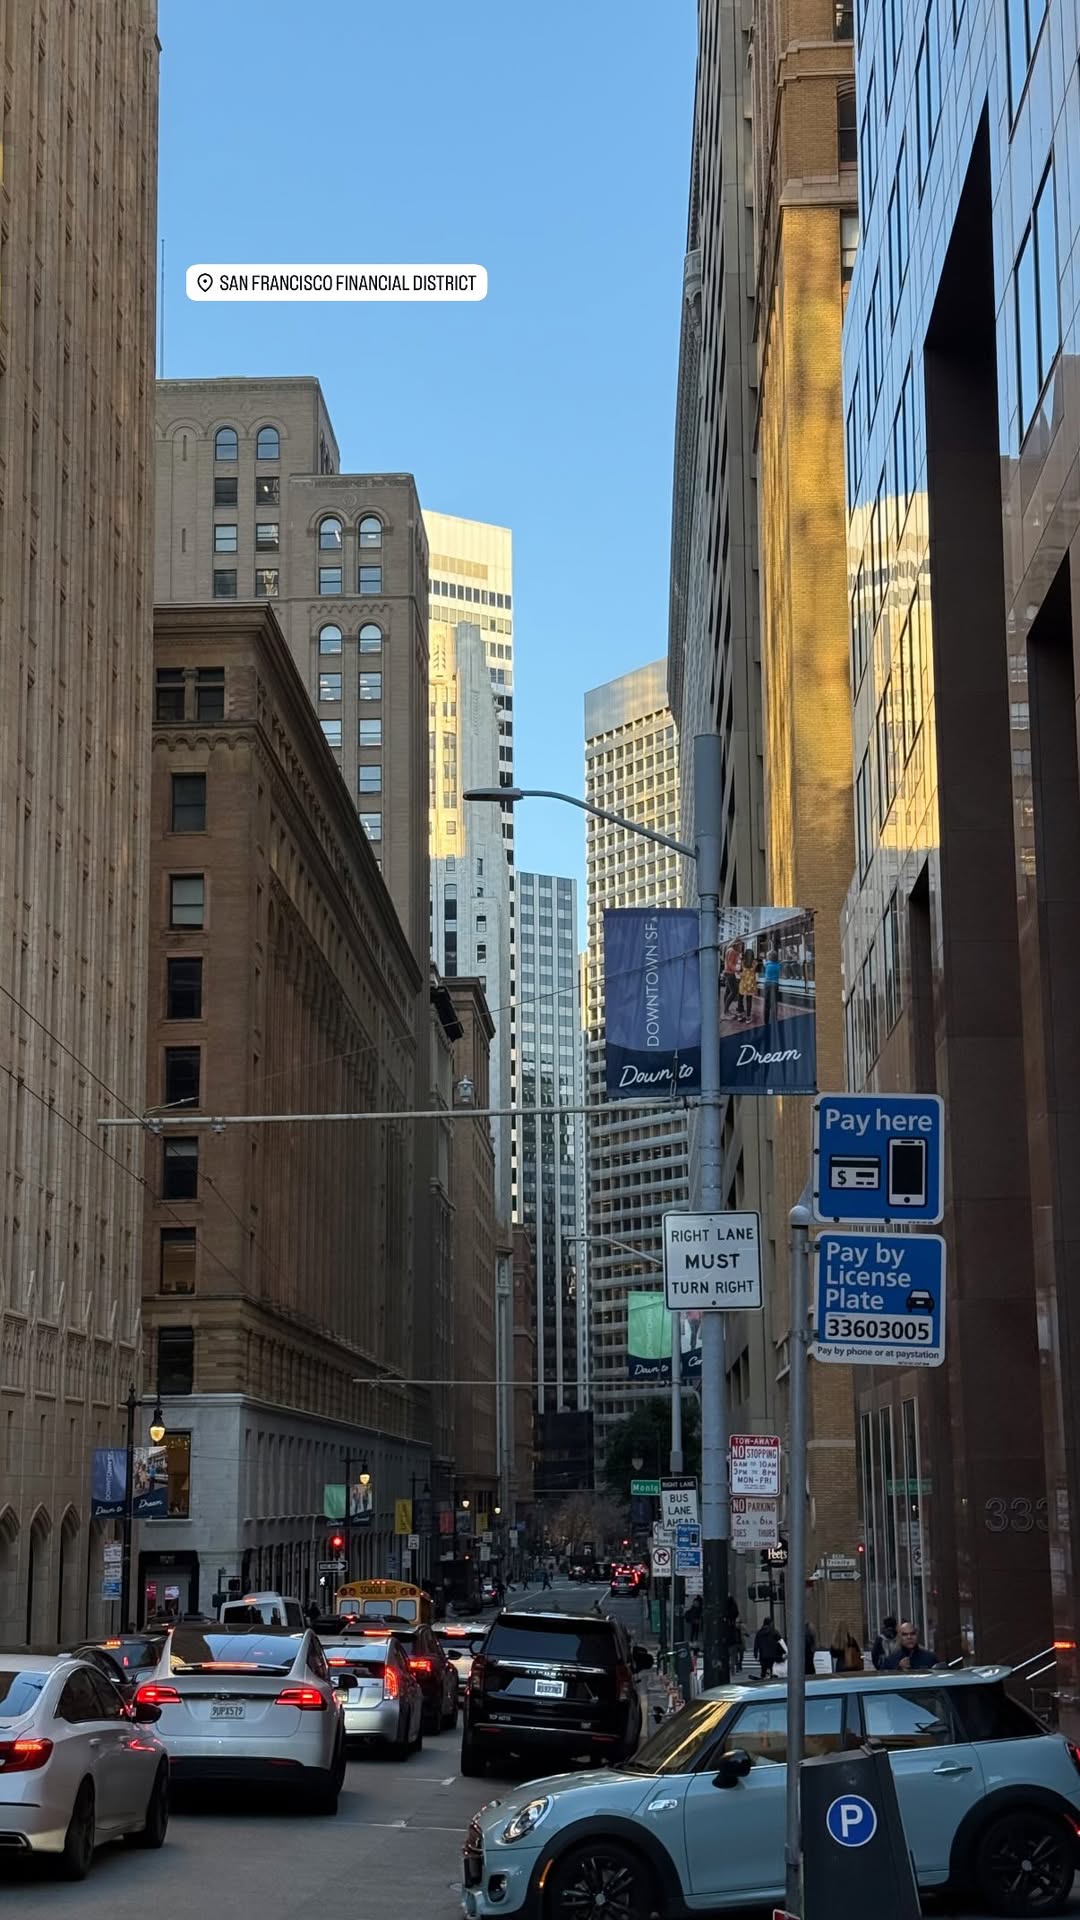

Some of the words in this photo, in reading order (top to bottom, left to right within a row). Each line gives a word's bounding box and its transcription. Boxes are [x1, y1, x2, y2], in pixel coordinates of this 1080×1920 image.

[645, 923, 658, 941] SF
[646, 946, 660, 1047] DOWNTOWN
[736, 1044, 802, 1067] Dream
[619, 1065, 673, 1088] Down
[678, 1063, 694, 1079] to
[825, 1108, 871, 1136] Pay
[876, 1108, 933, 1132] here
[671, 1229, 709, 1242] RIGHT
[717, 1228, 754, 1240] LANE
[685, 1253, 740, 1269] MUST
[826, 1241, 868, 1268] Pay
[876, 1242, 905, 1269] by
[826, 1265, 911, 1288] License
[671, 1281, 709, 1294] TURN
[715, 1280, 754, 1294] RIGHT
[825, 1288, 884, 1310] Plate
[827, 1318, 929, 1341] 33603005
[817, 1346, 831, 1356] Pay
[834, 1347, 844, 1357] by
[846, 1348, 872, 1359] phone
[885, 1349, 894, 1357] at
[896, 1350, 940, 1360] paystation
[734, 1437, 776, 1445] TOW-AWAY
[732, 1445, 745, 1458] NO
[746, 1448, 777, 1459] STOPPING
[669, 1494, 688, 1503] BUS
[732, 1499, 745, 1512] NO
[747, 1501, 776, 1512] PARKING
[668, 1506, 692, 1515] LANE
[360, 1585, 383, 1595] SCHOOL
[385, 1585, 397, 1595] BUS
[840, 1804, 864, 1837] P
